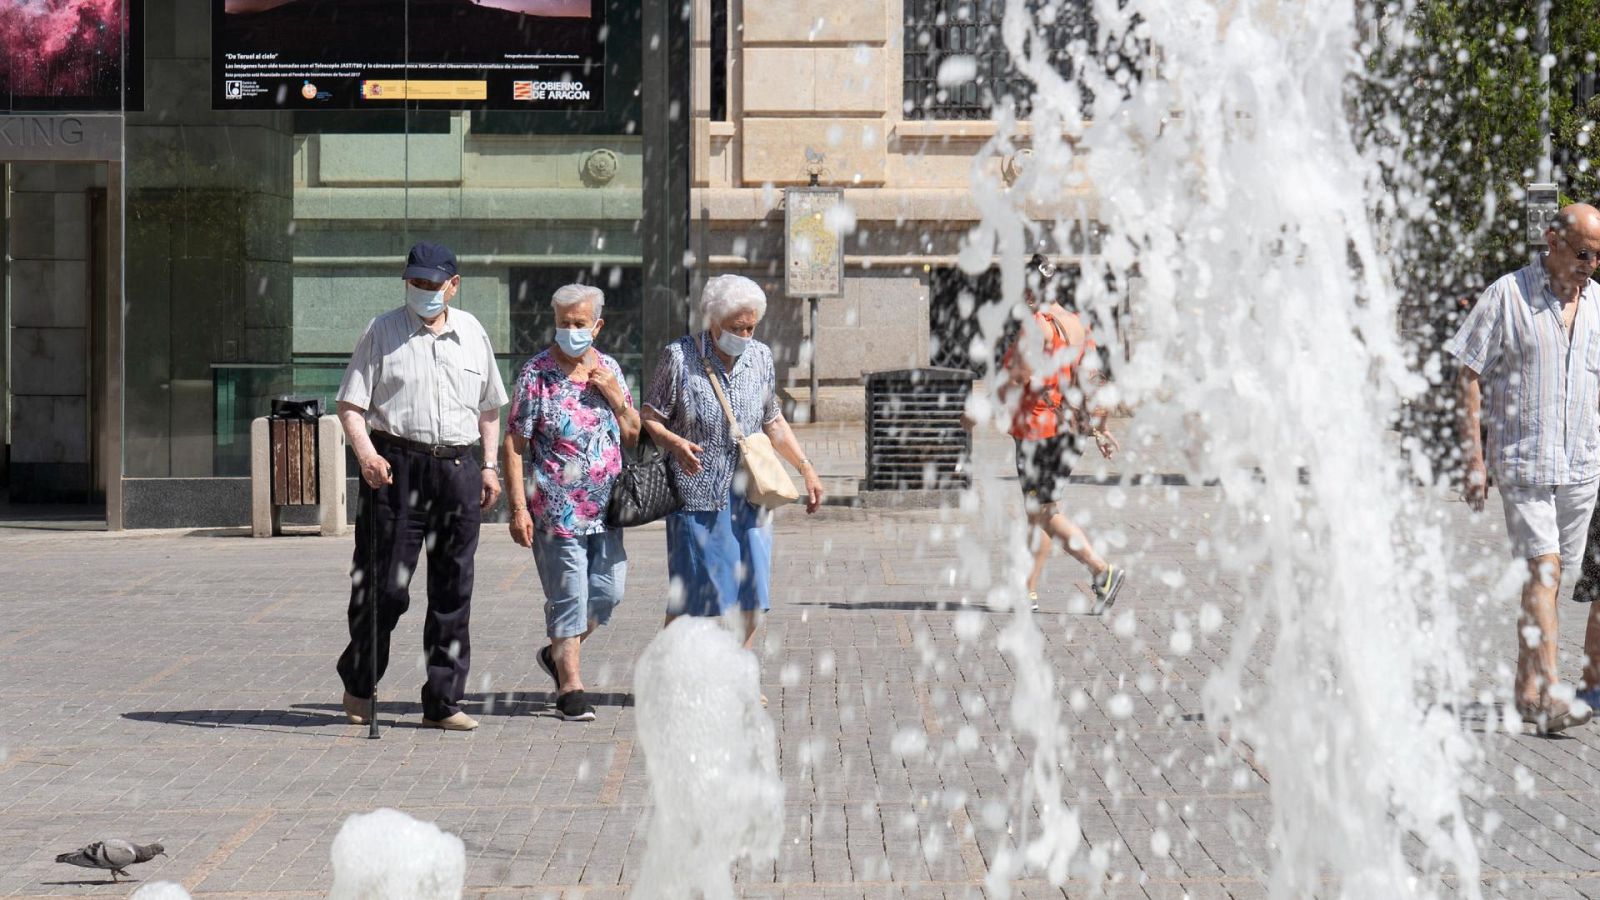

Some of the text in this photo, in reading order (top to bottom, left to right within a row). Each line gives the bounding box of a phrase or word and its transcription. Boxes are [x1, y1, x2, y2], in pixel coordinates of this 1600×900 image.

[532, 81, 583, 90] GOBIERNO
[532, 91, 590, 100] DE ARAGON
